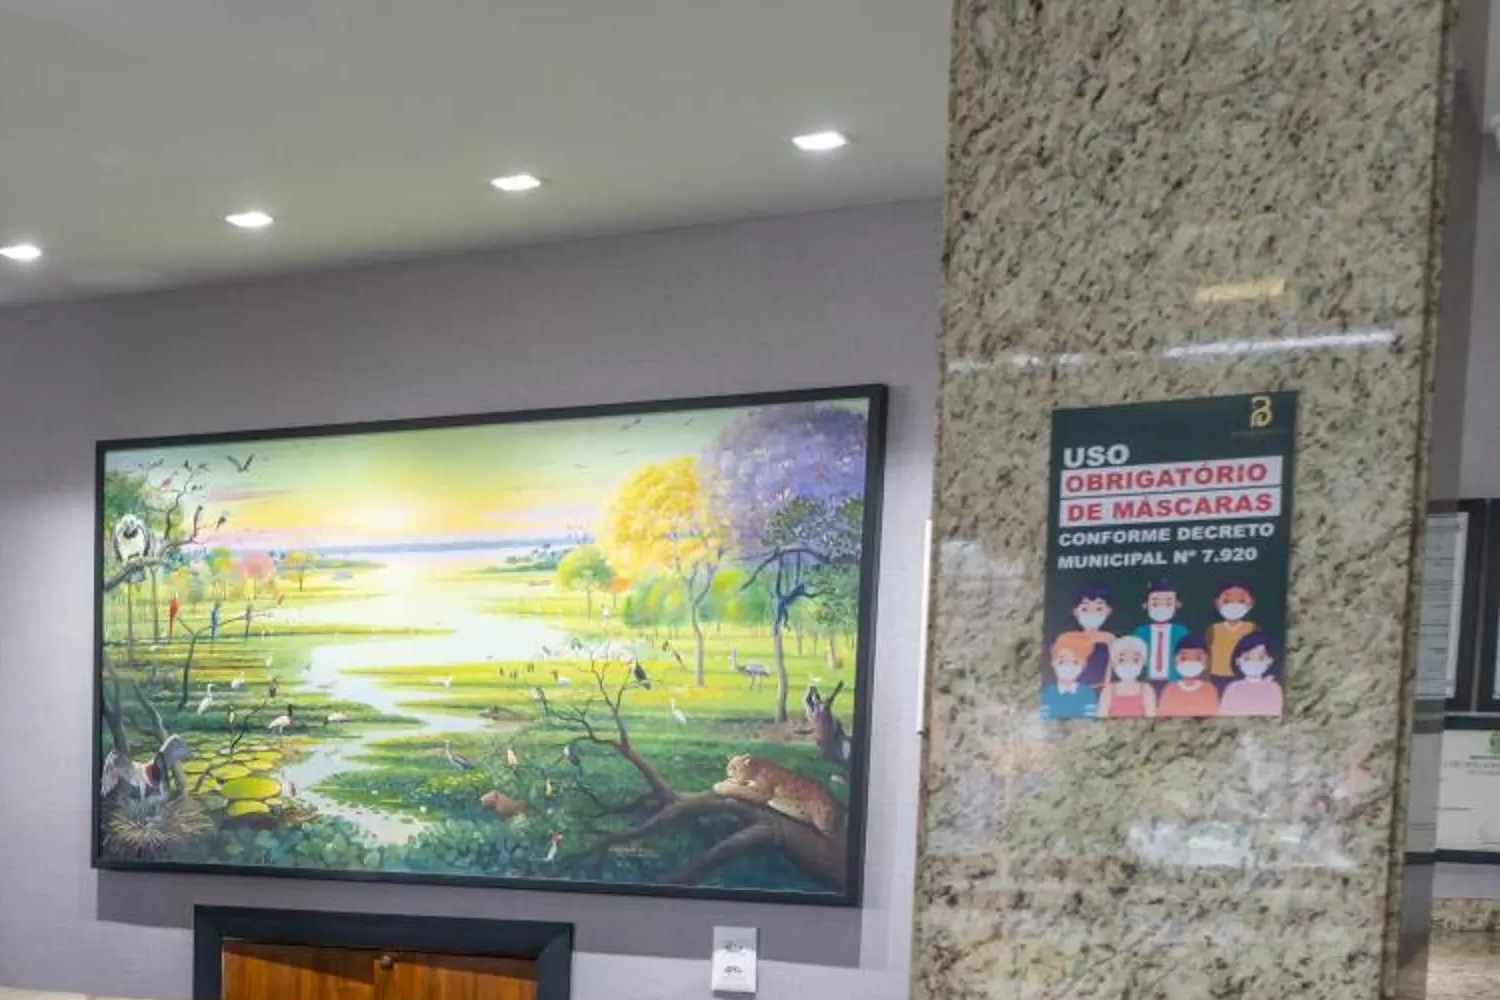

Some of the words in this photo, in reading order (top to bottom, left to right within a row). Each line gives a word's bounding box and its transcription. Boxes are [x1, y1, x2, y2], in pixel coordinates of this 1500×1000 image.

[1063, 444, 1131, 468] USO
[1065, 461, 1268, 493] OBRIGATÓRIO
[1066, 503, 1103, 522] DE
[1112, 492, 1274, 521] MÁSCARAS
[1058, 527, 1171, 547] CONFORME
[1176, 523, 1276, 542] DECRETO
[1057, 551, 1168, 569] MUNICIPAL
[1202, 547, 1259, 563] 7.920
